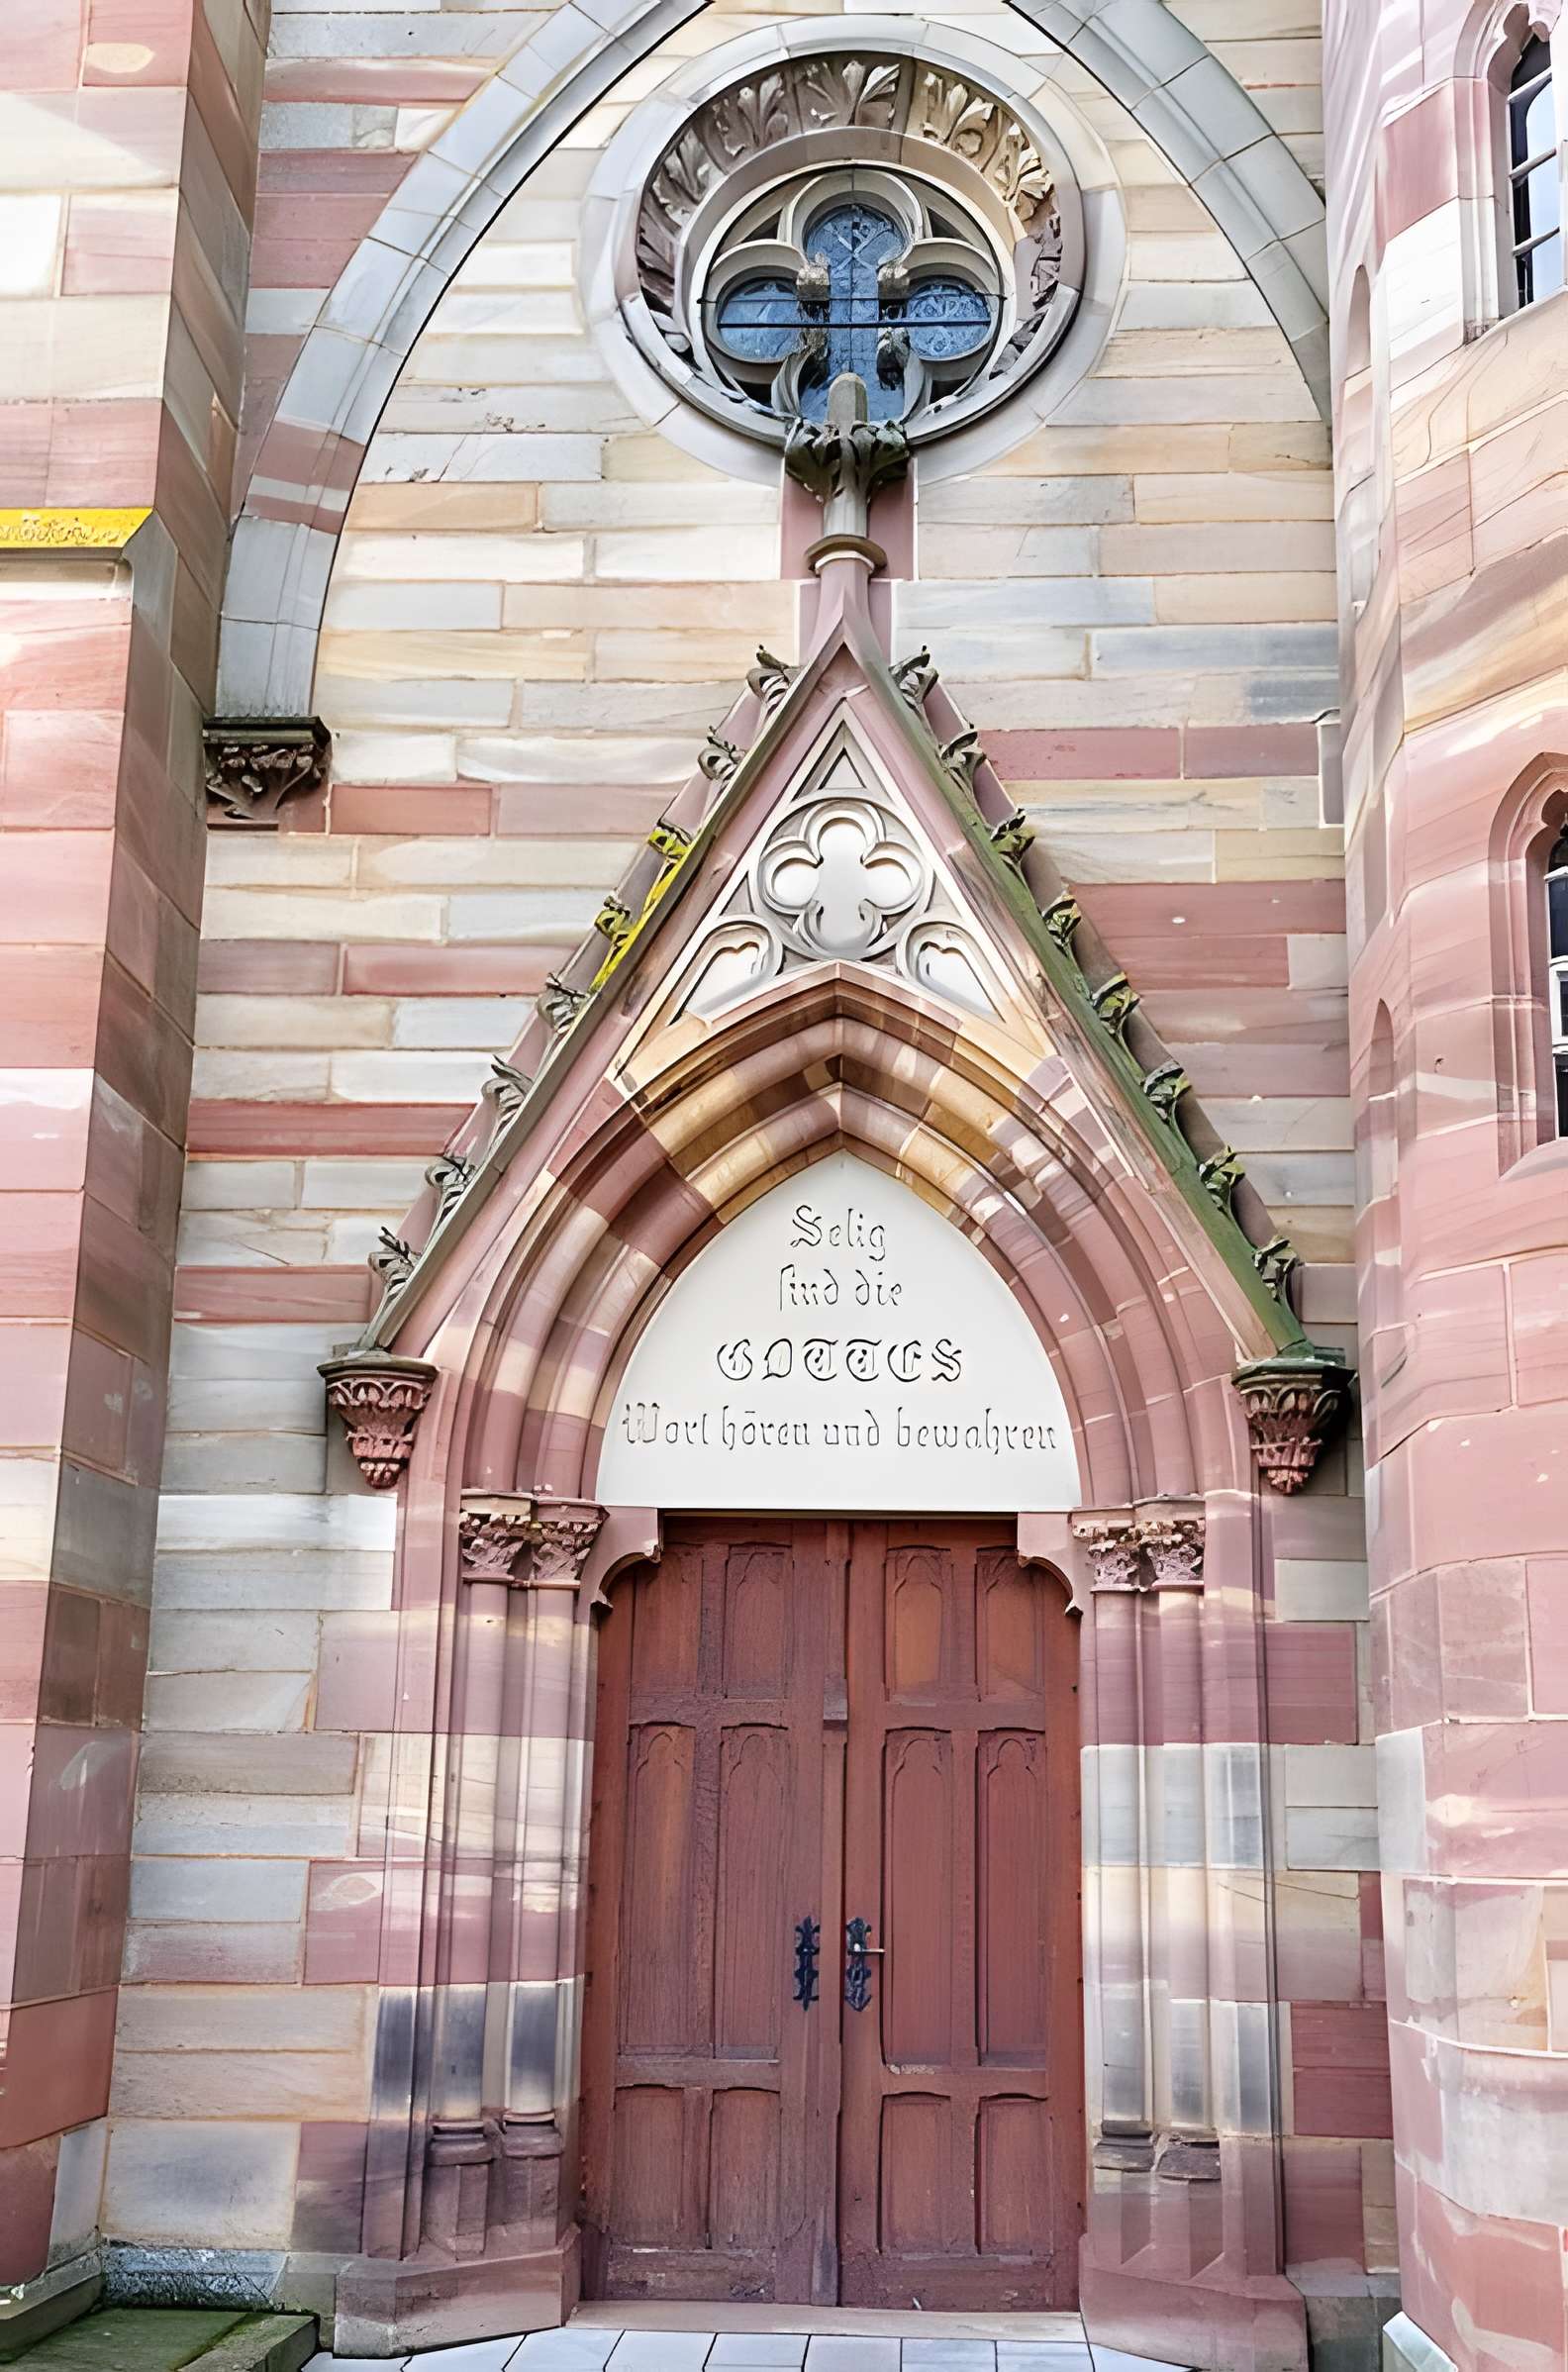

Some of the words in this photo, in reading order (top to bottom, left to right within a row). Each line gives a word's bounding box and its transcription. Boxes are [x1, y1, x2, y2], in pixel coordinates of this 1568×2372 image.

[790, 1204, 886, 1262] Selig
[854, 1268, 903, 1307] die
[716, 1336, 963, 1383] GOTTES
[823, 1409, 881, 1447] und
[896, 1406, 1057, 1456] bewahren
